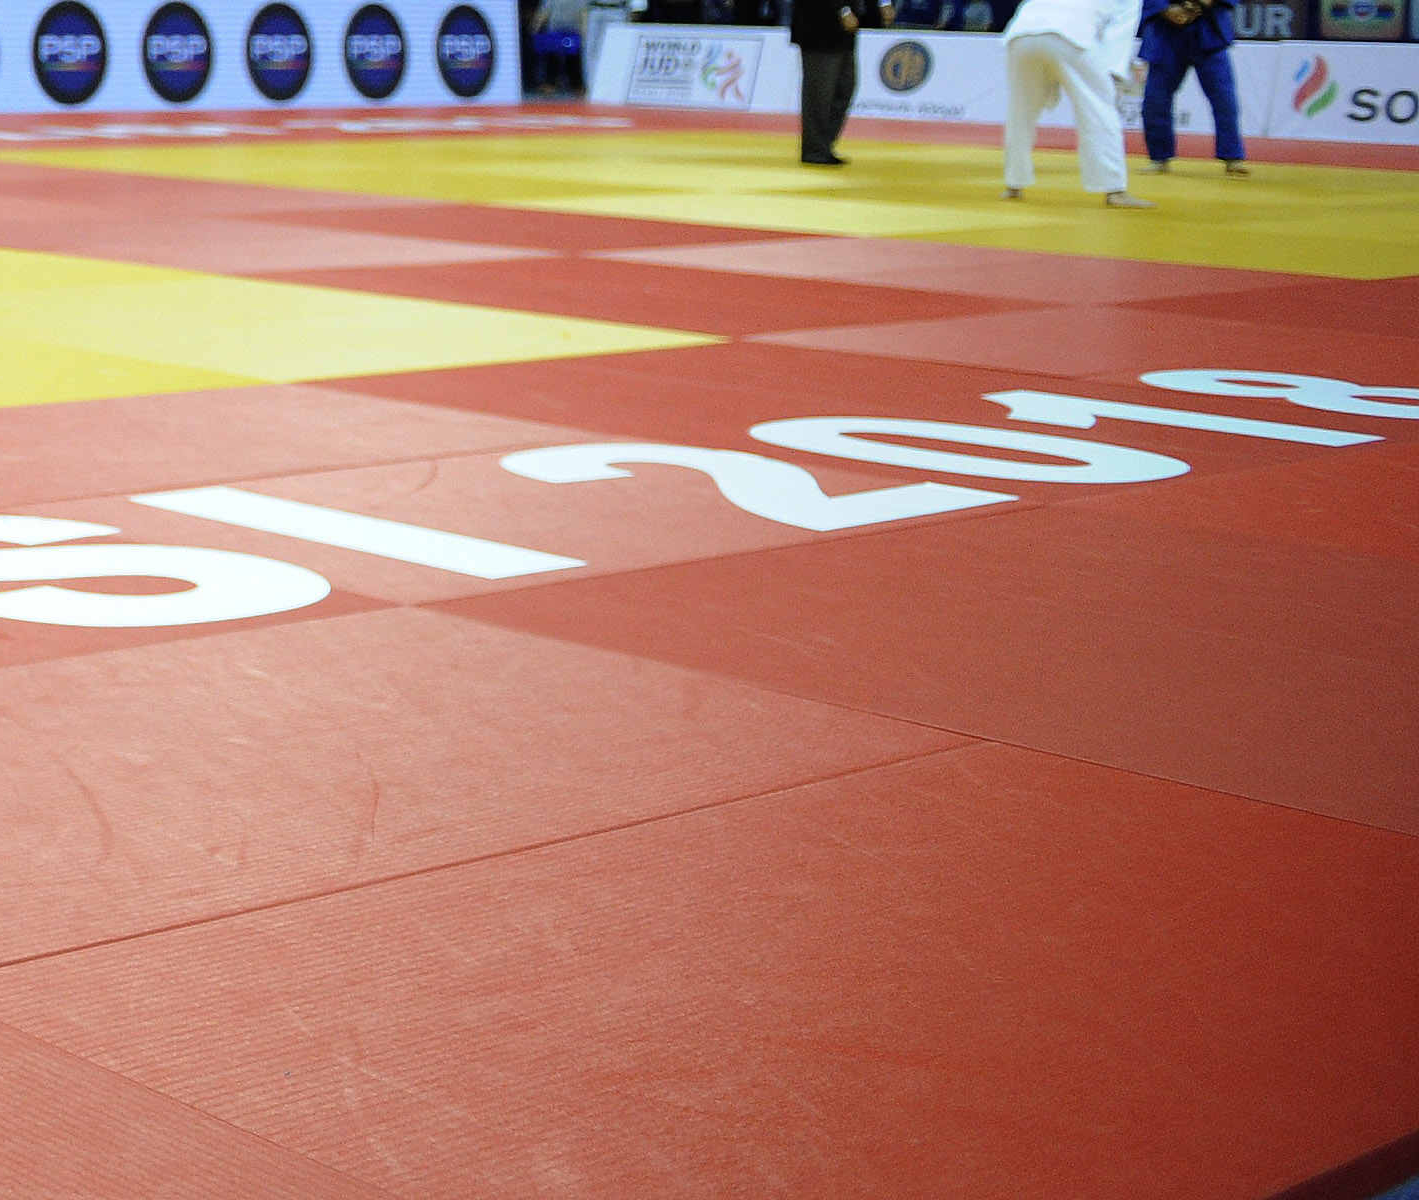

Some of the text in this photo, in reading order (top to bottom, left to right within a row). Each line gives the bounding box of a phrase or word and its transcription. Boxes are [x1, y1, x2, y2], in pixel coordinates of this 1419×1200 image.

[37, 34, 102, 62] PSP
[146, 34, 208, 62] PSP
[500, 368, 1419, 531] 2018
